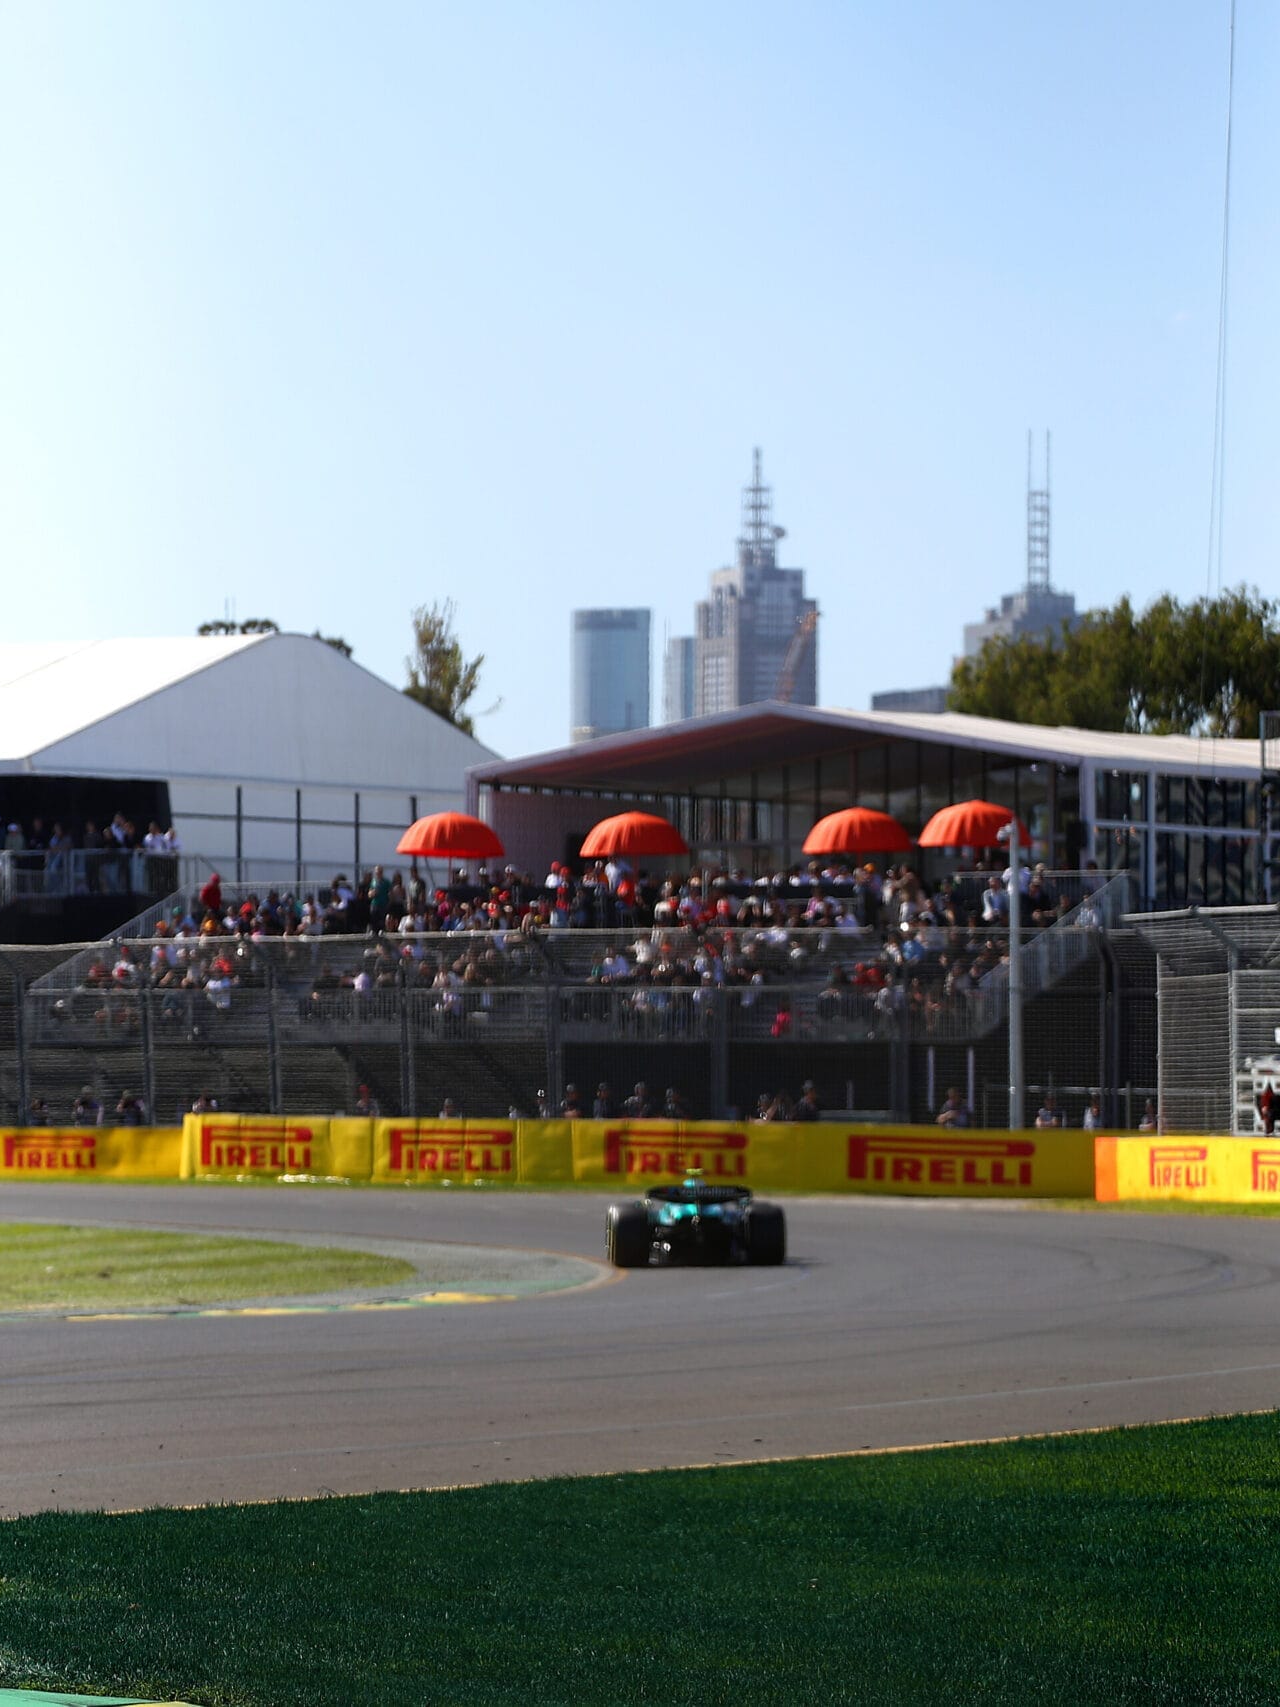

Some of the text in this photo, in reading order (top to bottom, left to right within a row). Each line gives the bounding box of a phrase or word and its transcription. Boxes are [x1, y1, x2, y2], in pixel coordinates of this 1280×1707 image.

[4, 1136, 96, 1169] PIRELLI
[201, 1126, 313, 1168] PIRELLI
[389, 1128, 513, 1172] PIRELLI
[604, 1130, 748, 1177] PIRELLI
[848, 1135, 1035, 1186] PIRELLI
[1150, 1146, 1207, 1187] PIRELLI
